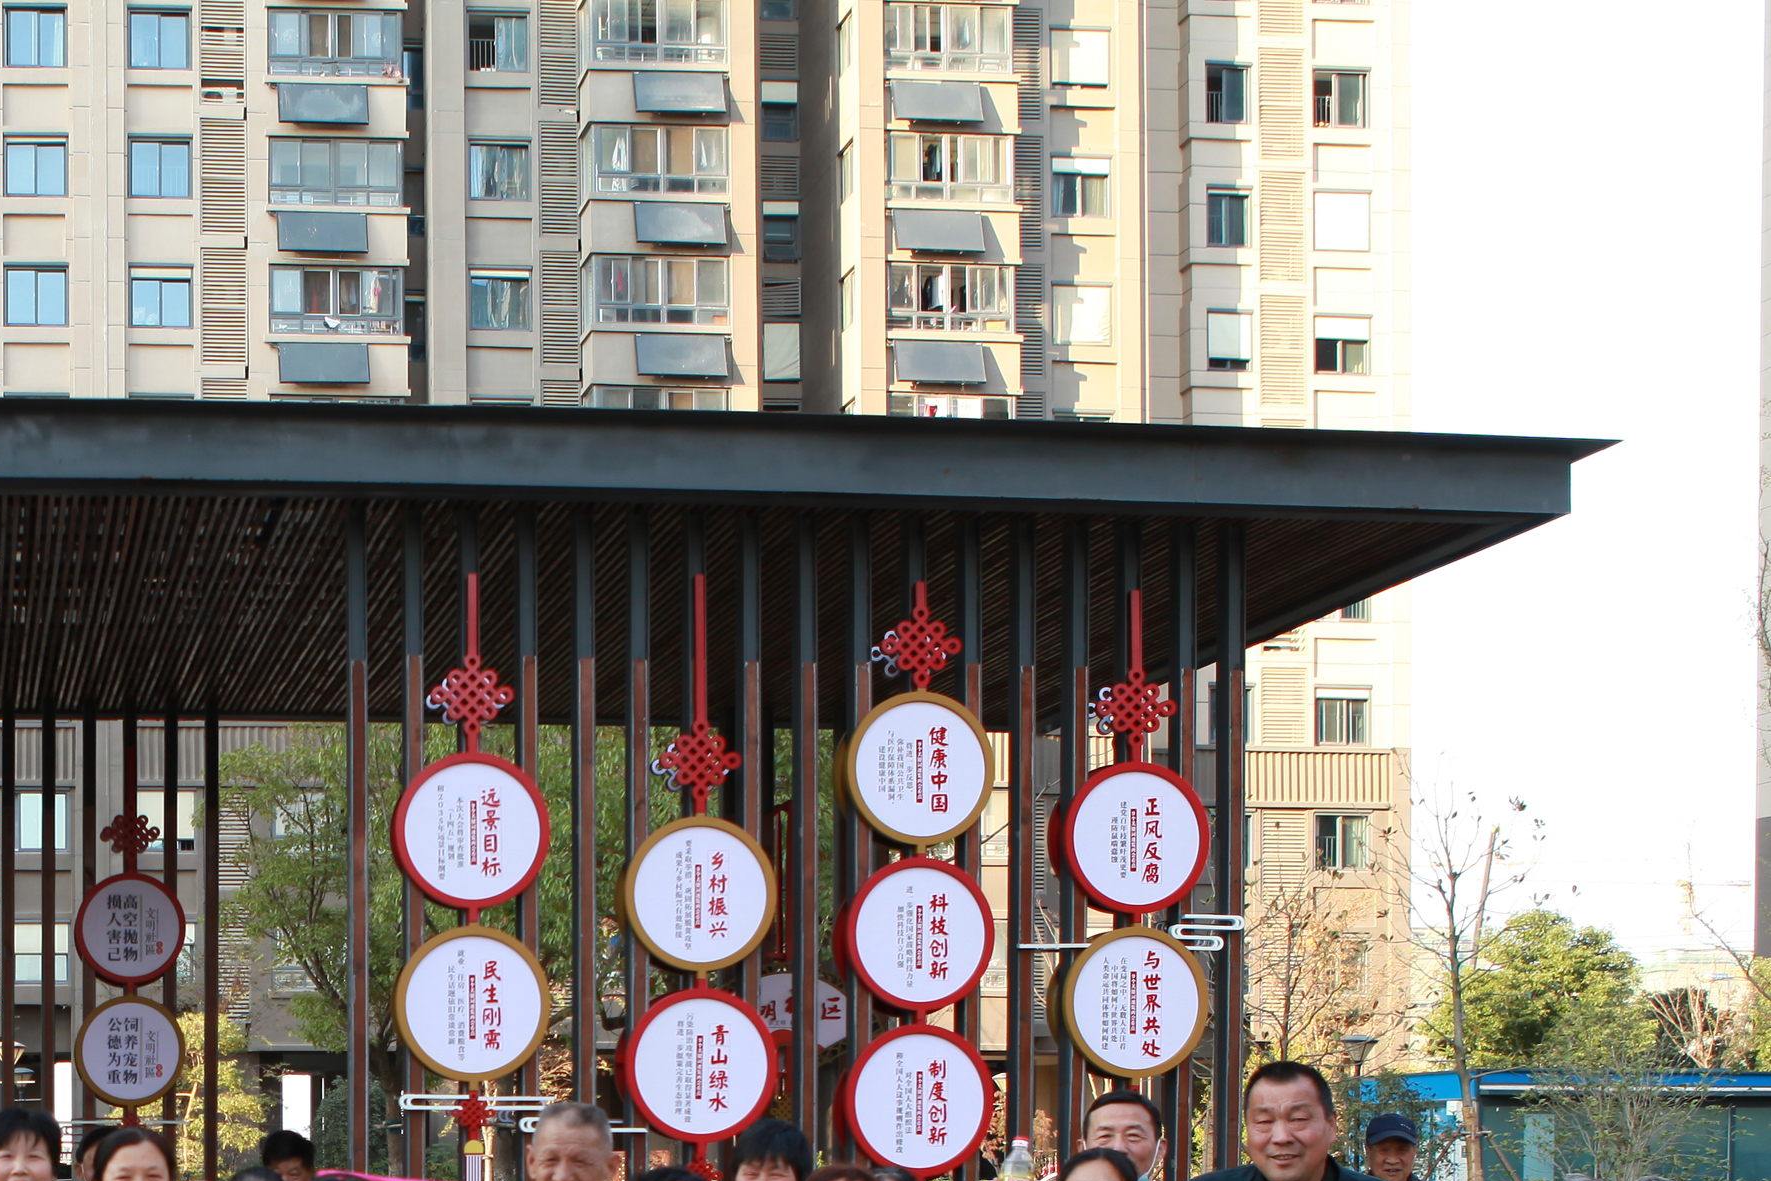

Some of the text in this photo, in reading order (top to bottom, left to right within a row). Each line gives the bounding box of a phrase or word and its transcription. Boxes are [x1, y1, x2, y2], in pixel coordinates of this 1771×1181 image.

[929, 727, 949, 813] 健康中国
[481, 788, 501, 876] 远景目标
[1142, 798, 1162, 883] 正风反腐
[107, 894, 122, 961] 损人害己
[123, 894, 138, 961] 高空抛物
[708, 852, 728, 938] 乡村振兴
[929, 893, 949, 980] 科技创新
[483, 961, 501, 1050] 民生刚需
[1142, 951, 1161, 1057] 与世界共处
[107, 1018, 122, 1084] 公德为重
[123, 1018, 138, 1084] 饲养宠物
[709, 1025, 729, 1112] 青山绿水
[928, 1060, 947, 1145] 制度创新
